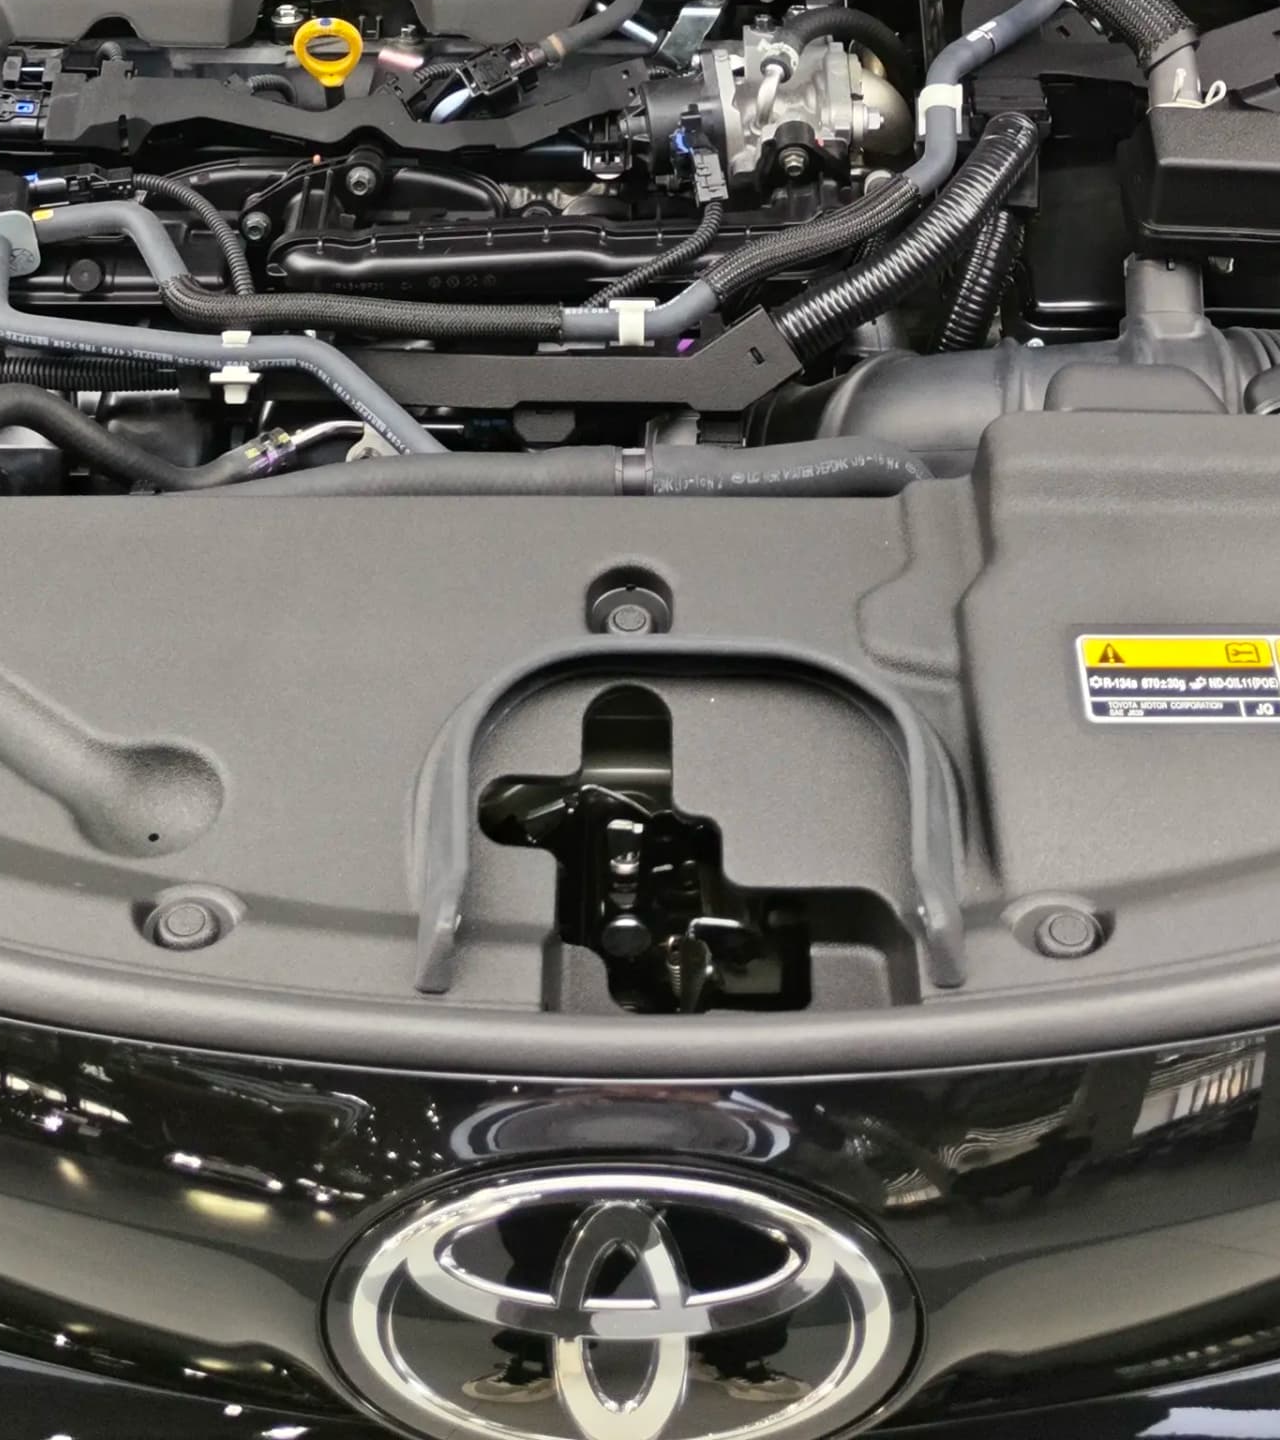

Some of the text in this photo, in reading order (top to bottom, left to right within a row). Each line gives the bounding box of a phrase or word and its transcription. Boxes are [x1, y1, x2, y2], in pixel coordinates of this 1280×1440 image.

[1103, 676, 1138, 689] R-134a
[1108, 701, 1224, 710] TOYOTA MOTOR CORPORATION
